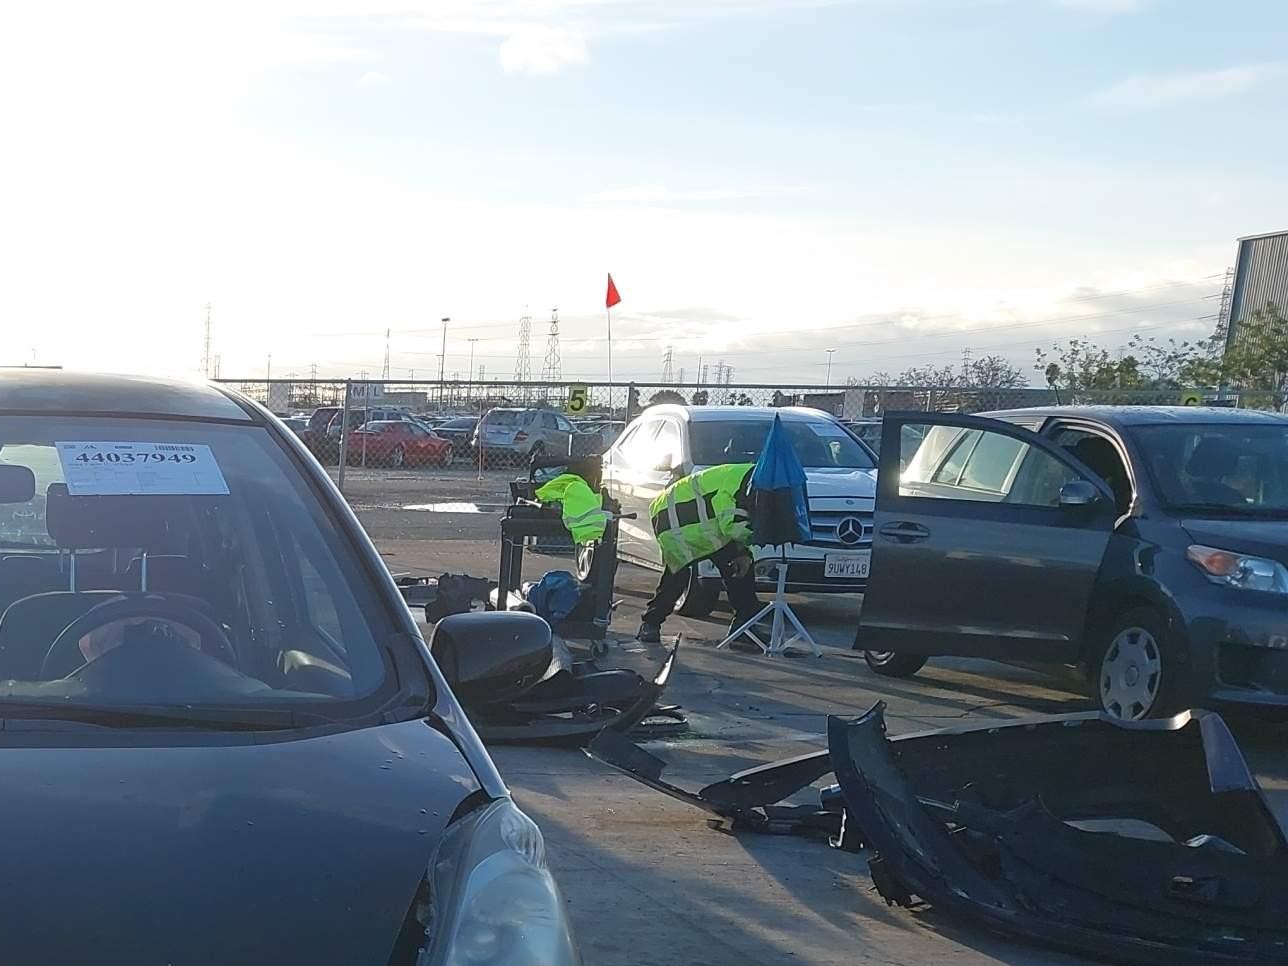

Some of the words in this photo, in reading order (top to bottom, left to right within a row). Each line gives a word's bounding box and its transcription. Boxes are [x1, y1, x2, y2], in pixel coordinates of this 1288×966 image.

[570, 389, 585, 411] 5
[75, 452, 197, 464] 44037949
[828, 562, 868, 576] 9UWY148
